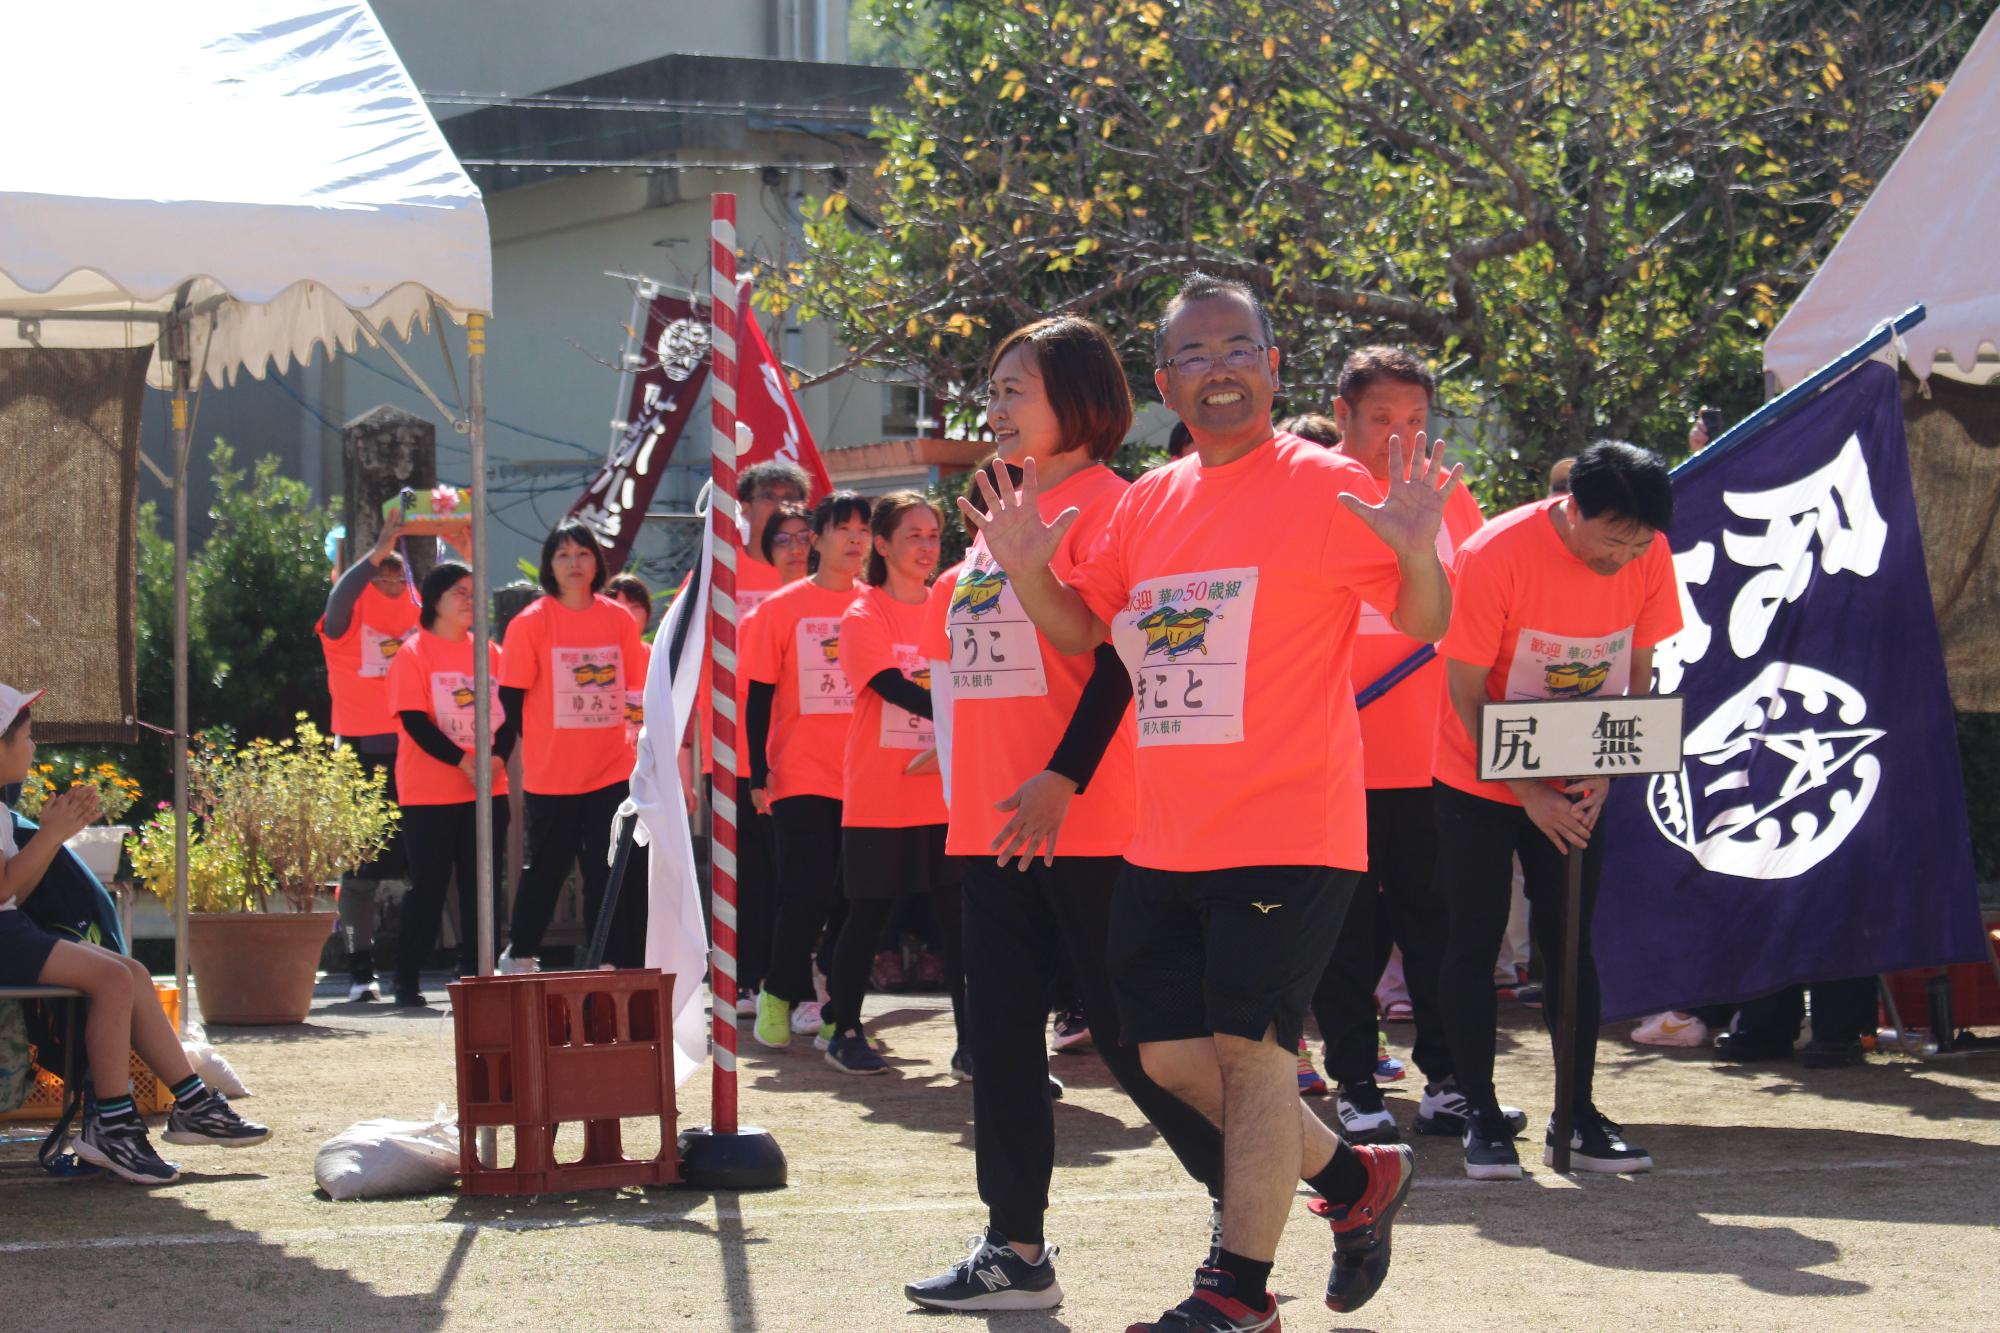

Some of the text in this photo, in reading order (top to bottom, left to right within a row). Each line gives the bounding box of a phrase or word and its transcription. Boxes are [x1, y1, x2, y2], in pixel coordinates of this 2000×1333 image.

[1158, 577, 1242, 606] 華の50歳組
[950, 627, 1006, 667] うこ
[1529, 635, 1562, 659] 歓迎
[572, 695, 618, 713] ゆみこ
[1489, 711, 1643, 773] 尻無
[975, 1264, 1012, 1292] N
